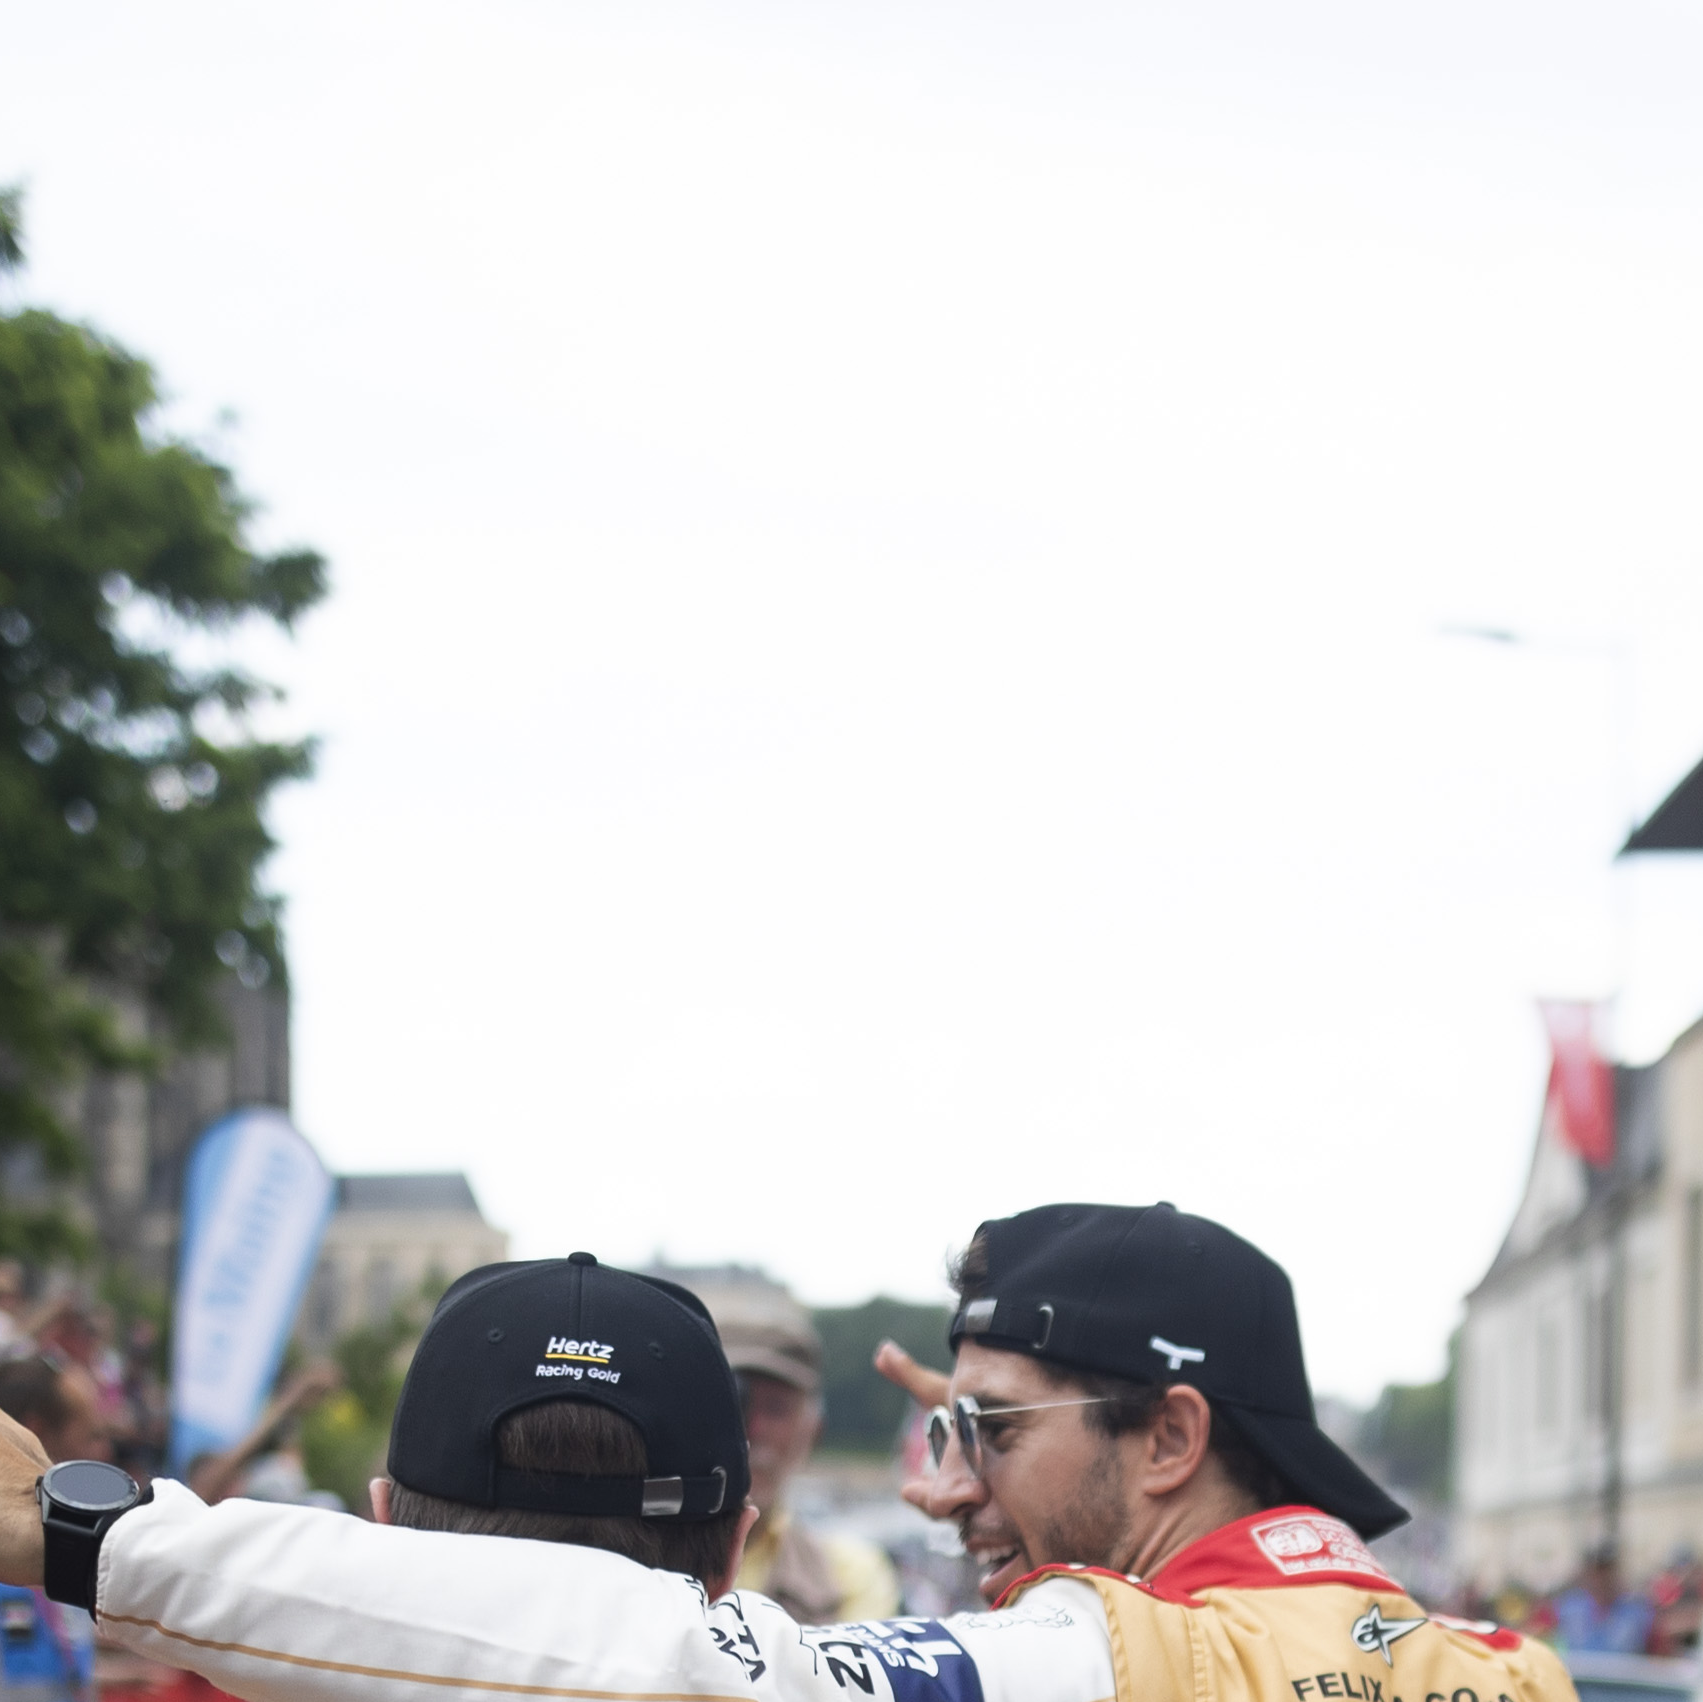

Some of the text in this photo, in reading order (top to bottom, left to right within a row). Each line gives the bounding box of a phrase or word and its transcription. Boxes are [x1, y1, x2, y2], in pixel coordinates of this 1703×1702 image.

[547, 1336, 615, 1359] Hertz
[535, 1364, 622, 1384] Racing Gold
